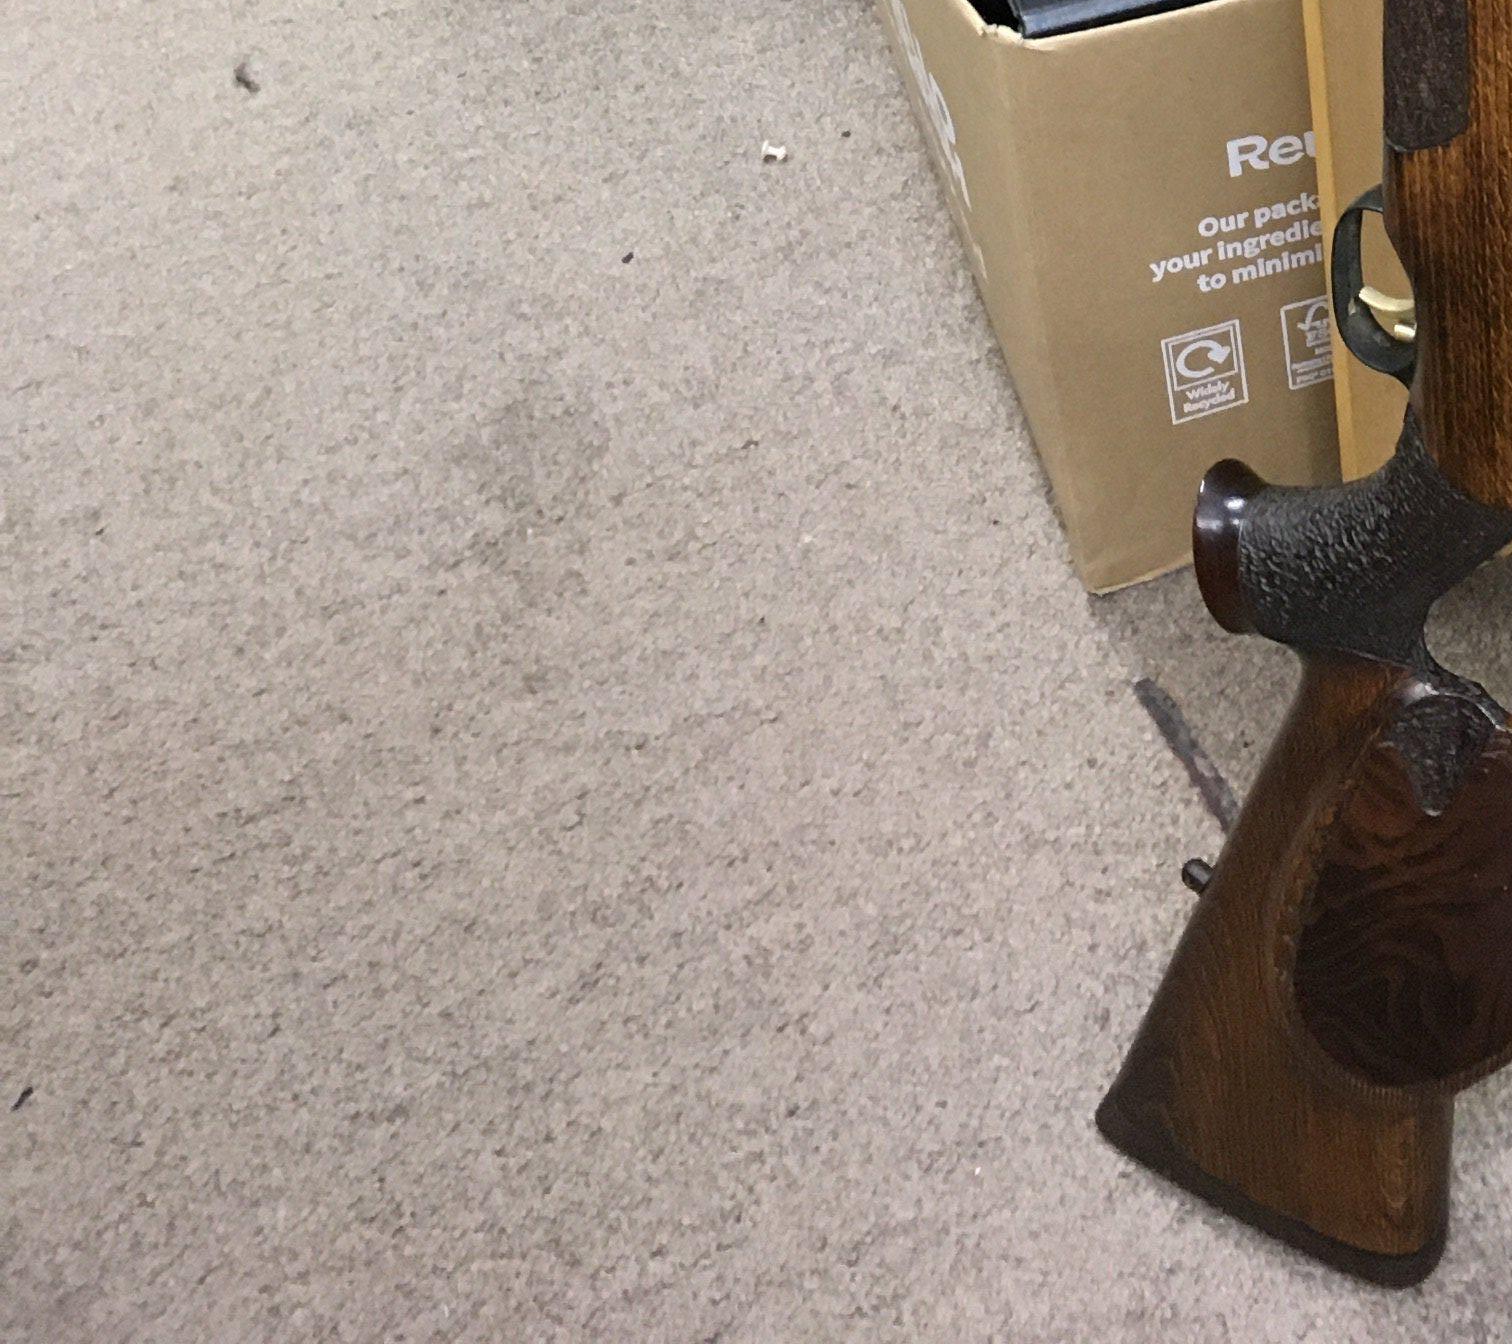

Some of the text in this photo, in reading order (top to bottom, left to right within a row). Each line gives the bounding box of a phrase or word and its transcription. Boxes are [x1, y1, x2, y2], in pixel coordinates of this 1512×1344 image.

[1198, 192, 1320, 237] Our pack
[1150, 248, 1213, 283] your
[1197, 273, 1227, 292] to
[1183, 387, 1236, 413] Recycled
[1186, 380, 1230, 400] Widely
